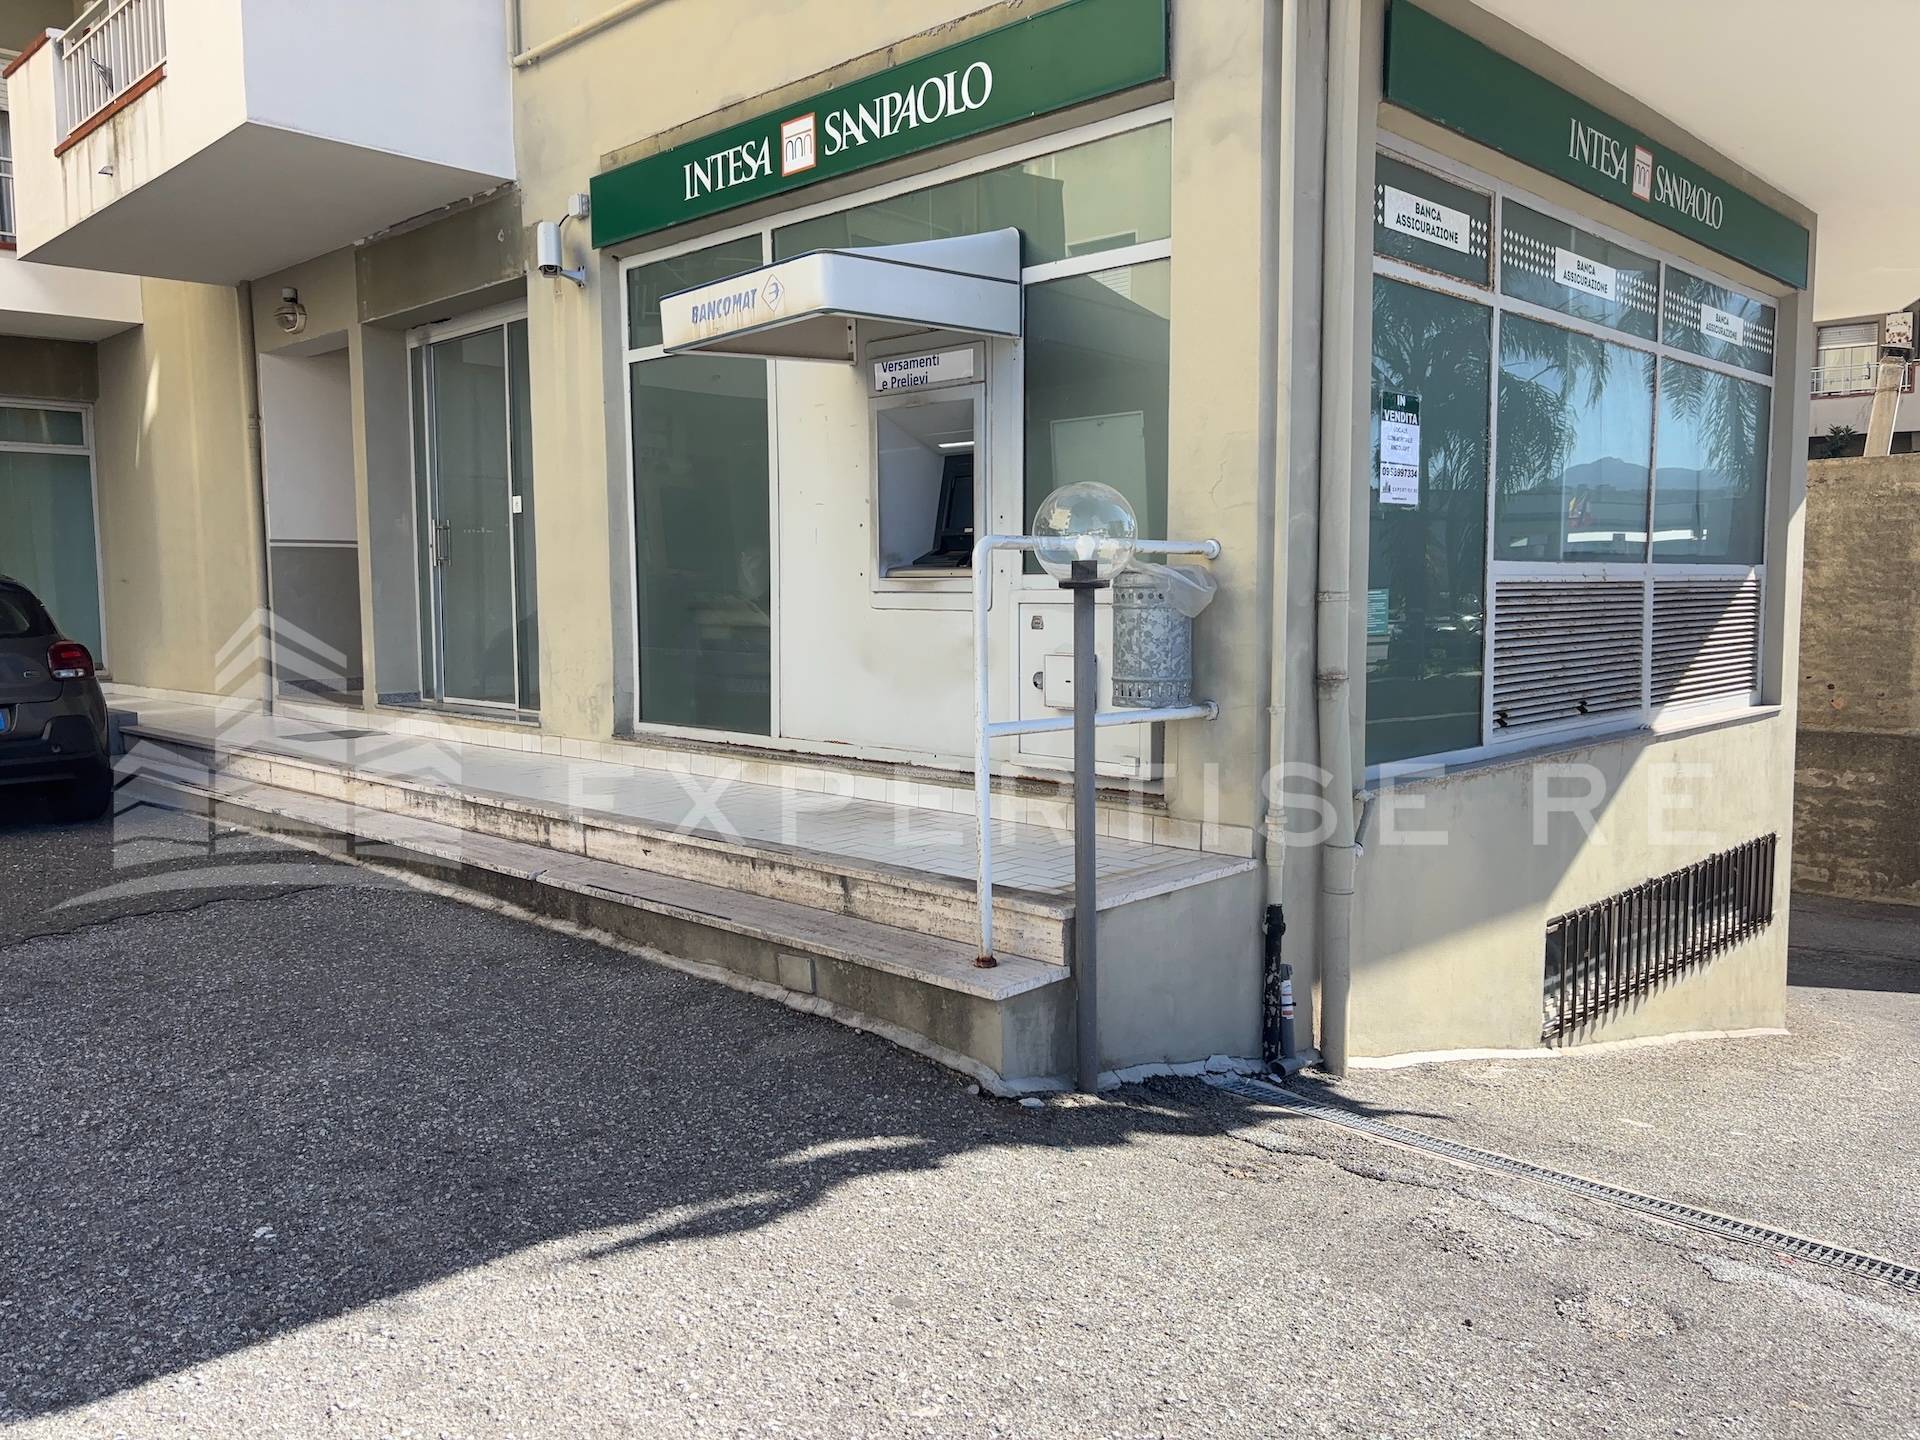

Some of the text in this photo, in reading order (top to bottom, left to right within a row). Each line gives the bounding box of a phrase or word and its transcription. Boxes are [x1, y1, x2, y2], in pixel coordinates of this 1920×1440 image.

[683, 61, 992, 200] INTESA SANPAOLO
[1568, 118, 1723, 230] INTESA SANPAOLO
[1415, 202, 1442, 222] BANCA
[1396, 212, 1459, 244] ASSICURAZIONE
[1577, 259, 1596, 276] BANCA
[1563, 269, 1608, 294] ASSICURAZIONE
[691, 287, 757, 324] BANCOMAT
[881, 354, 940, 373] Versamenti
[881, 372, 928, 390] e Prelievi
[1396, 394, 1406, 407] IN
[1384, 409, 1418, 425] VENDITA
